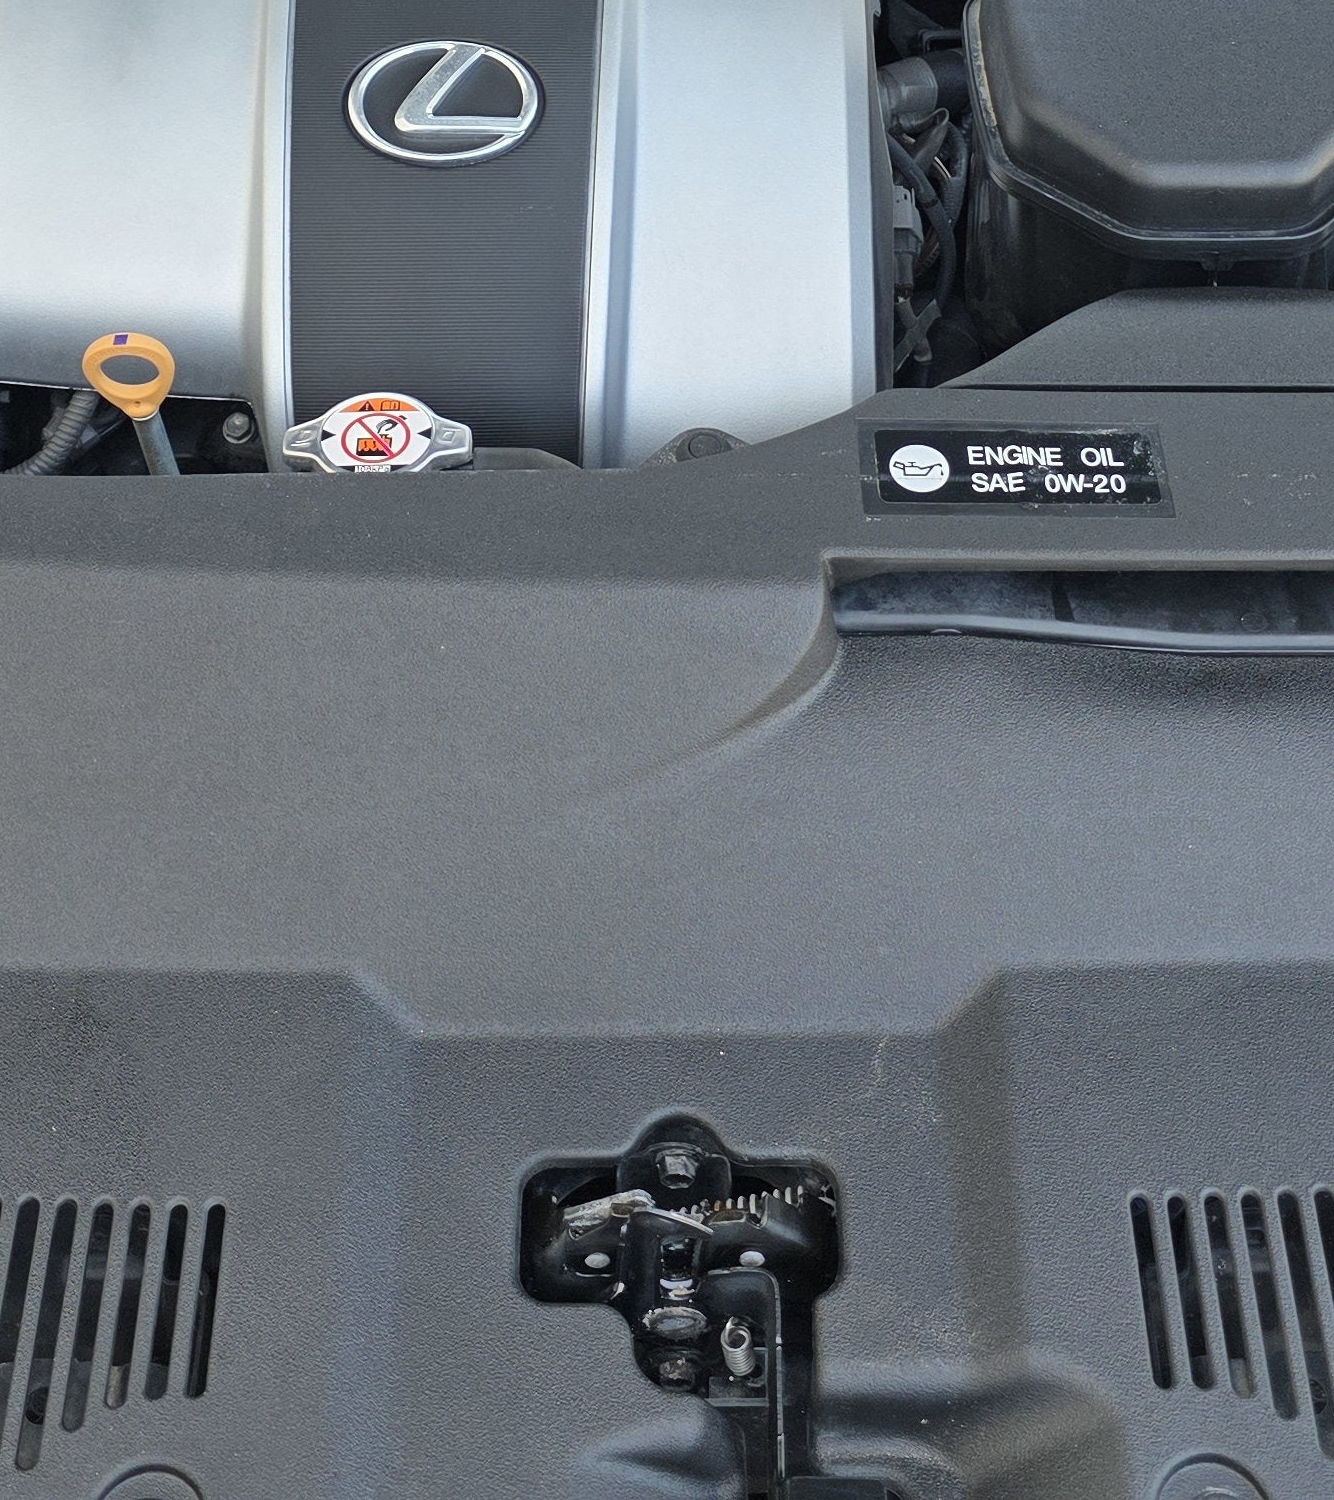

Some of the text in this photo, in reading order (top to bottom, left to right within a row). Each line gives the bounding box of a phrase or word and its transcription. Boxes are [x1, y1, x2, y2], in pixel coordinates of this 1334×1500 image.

[967, 445, 1125, 467] ENGINE OIL
[970, 472, 1127, 494] SAE 0W-20
